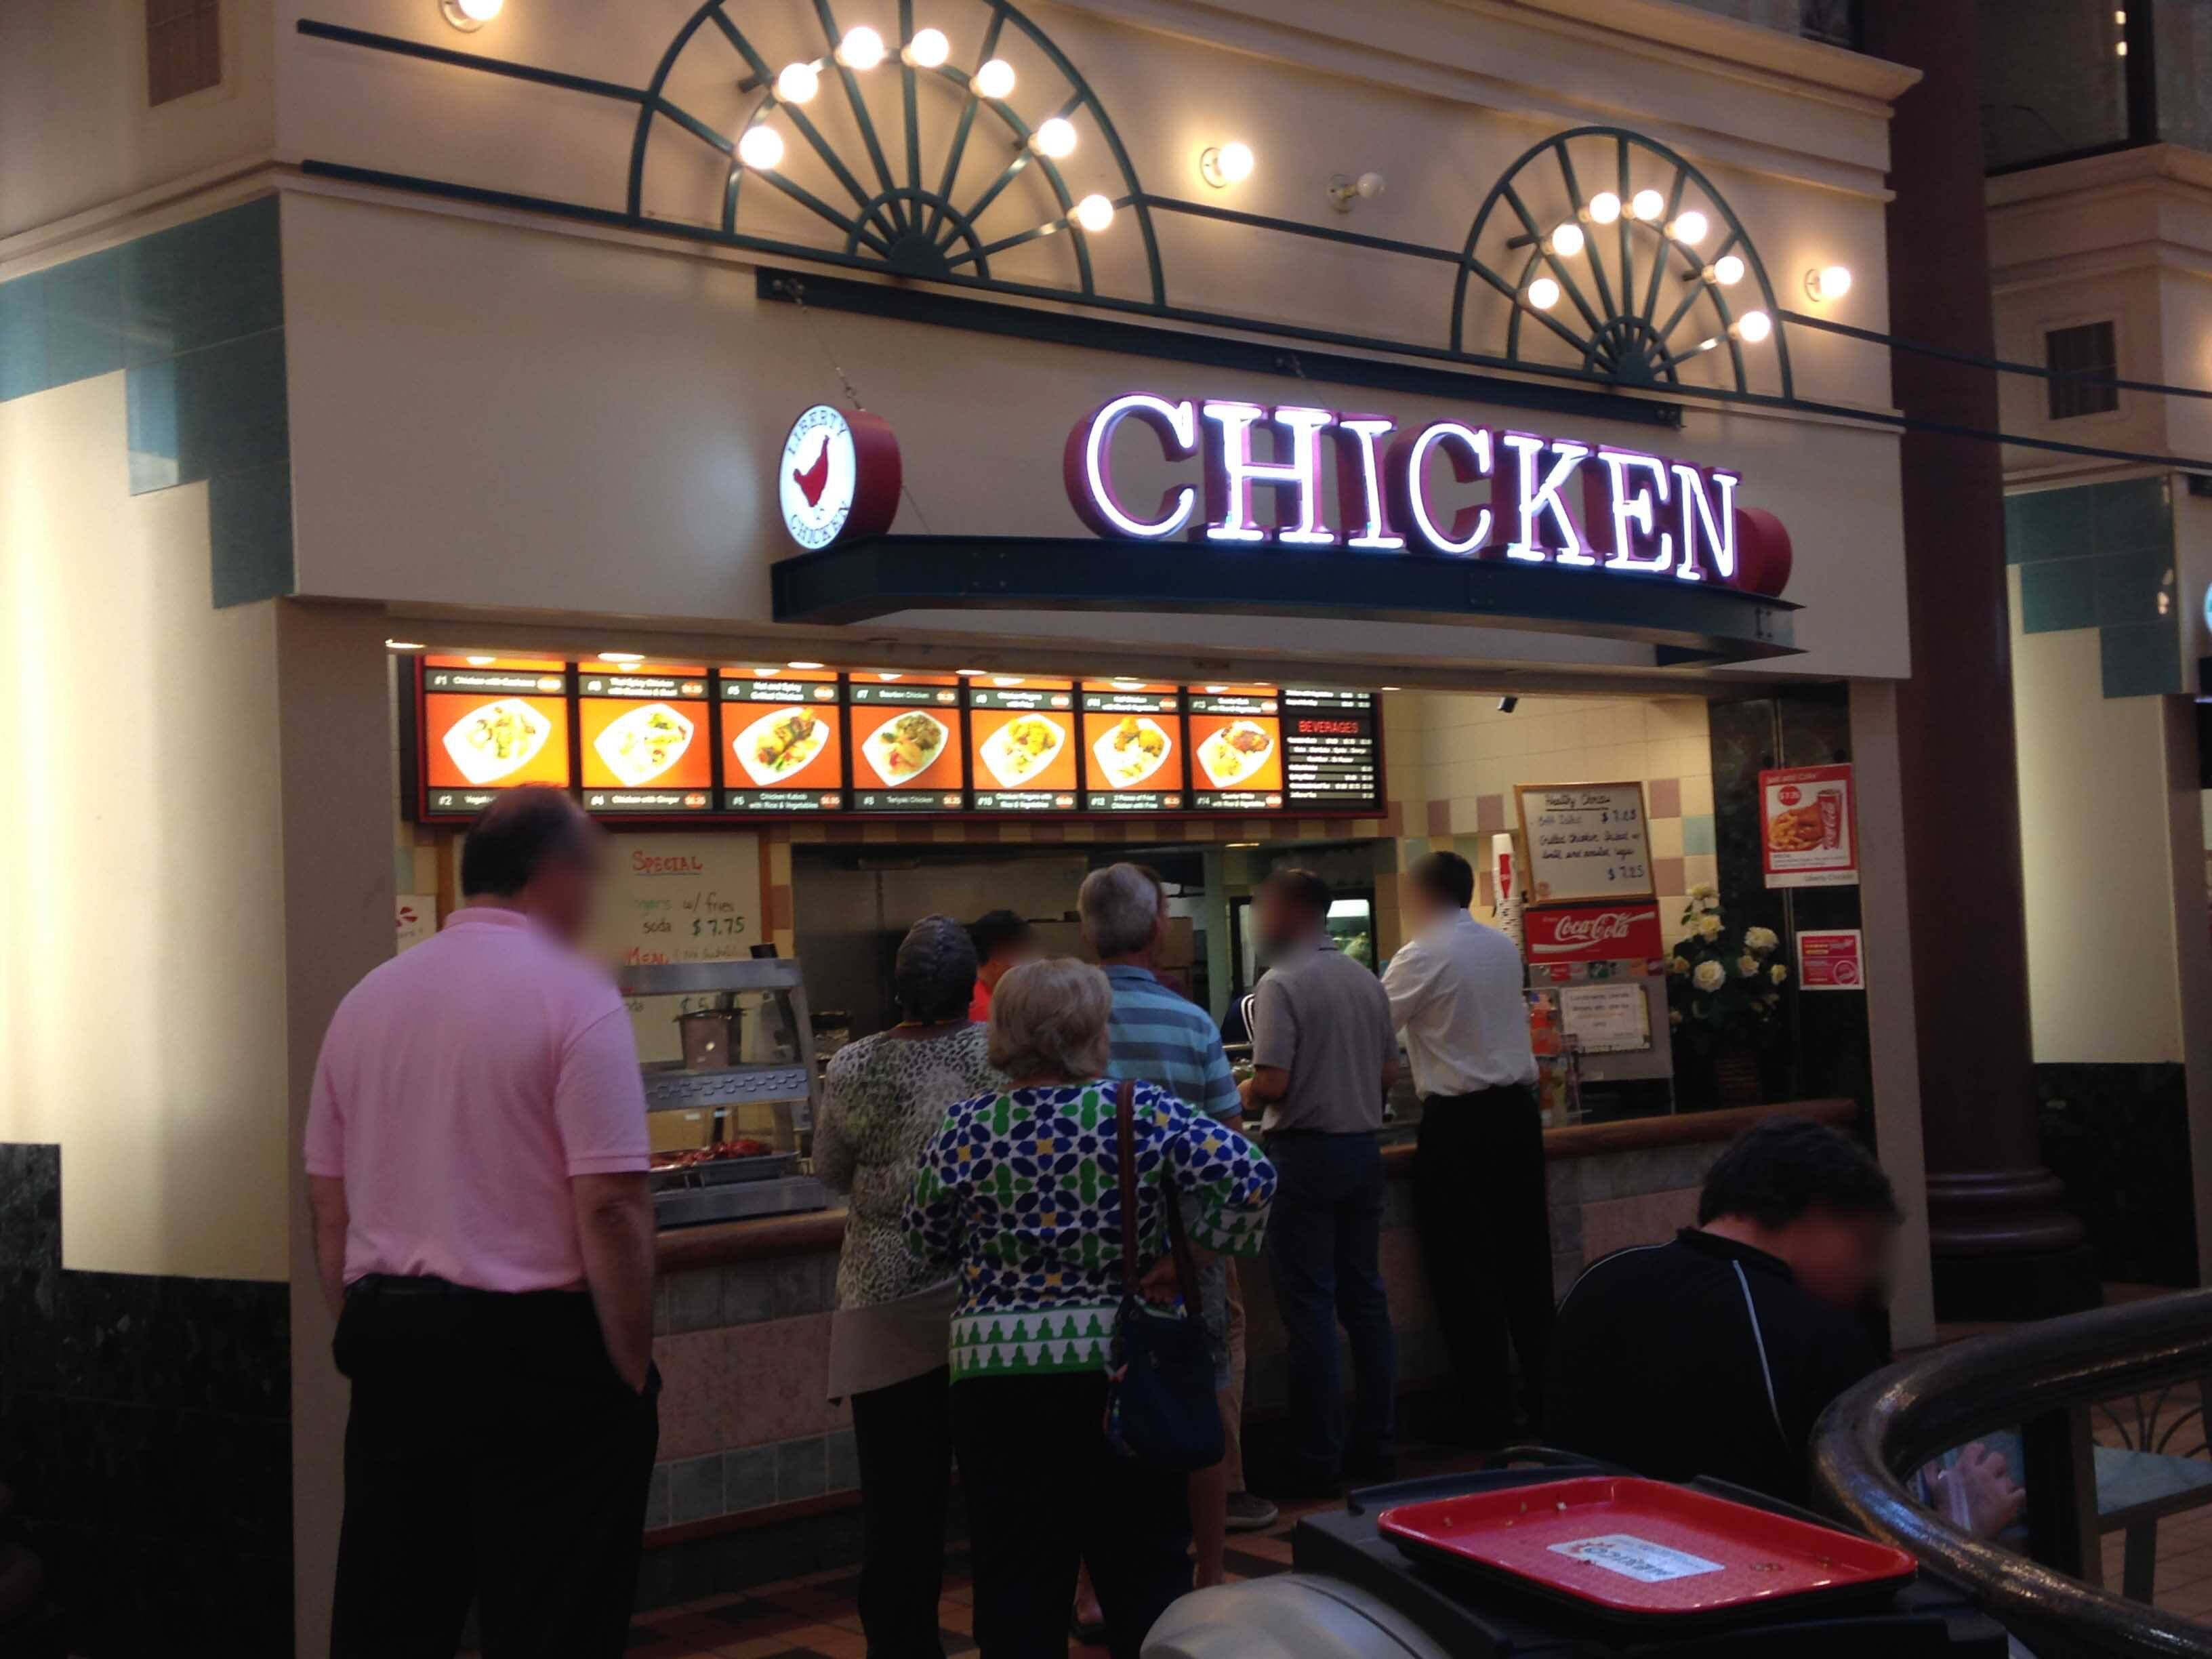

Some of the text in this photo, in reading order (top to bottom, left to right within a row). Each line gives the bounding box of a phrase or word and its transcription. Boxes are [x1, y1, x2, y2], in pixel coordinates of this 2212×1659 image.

[788, 409, 849, 455] LIBERTY
[1082, 392, 1742, 581] CHICKEN
[1298, 720, 1359, 734] BEVERAGES
[643, 917, 672, 935] soda
[1554, 913, 1630, 941] Coca-Cola
